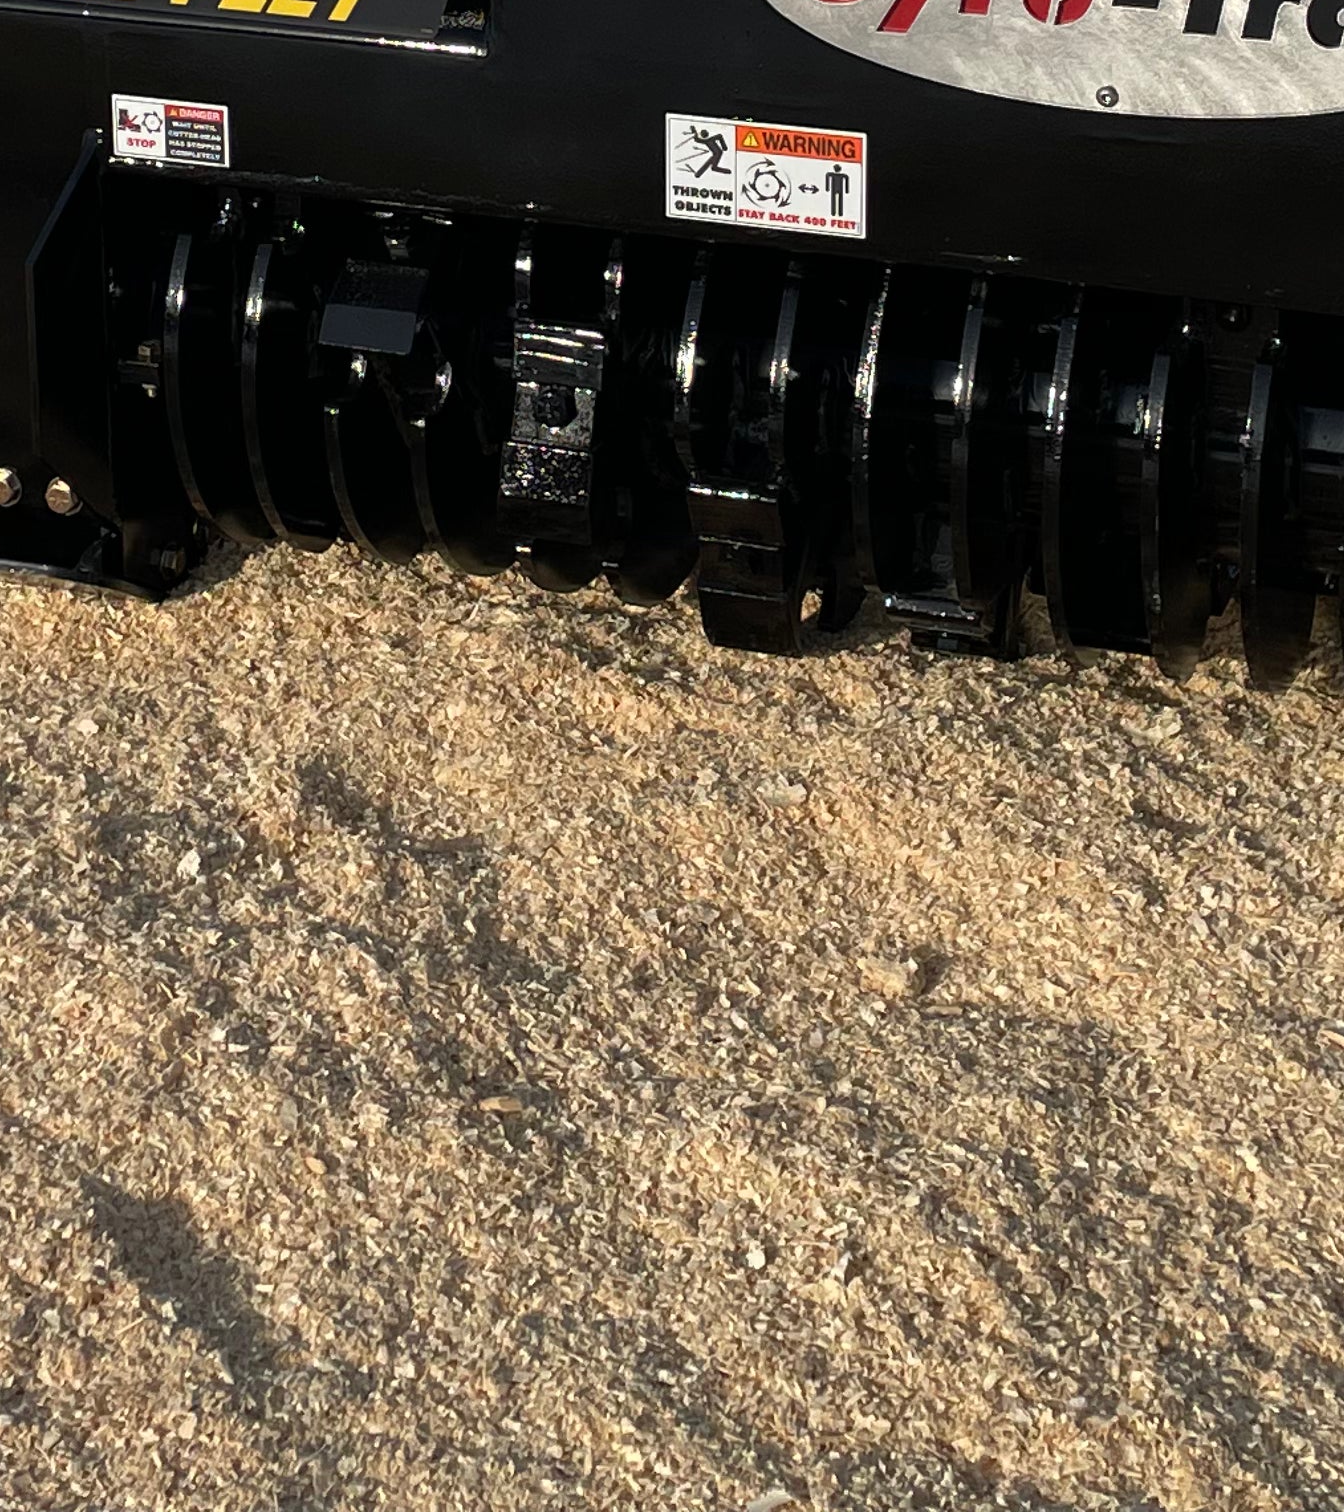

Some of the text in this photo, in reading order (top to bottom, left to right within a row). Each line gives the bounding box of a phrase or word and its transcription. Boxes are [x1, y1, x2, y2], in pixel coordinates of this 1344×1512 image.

[179, 108, 220, 121] DANGER
[127, 138, 156, 148] STOP
[762, 132, 856, 159] WARNING
[170, 149, 221, 160] COMPLETELY
[672, 185, 734, 201] THROWN
[675, 200, 732, 216] OBJECTS
[738, 209, 856, 230] STAY BACK 400 FEET
